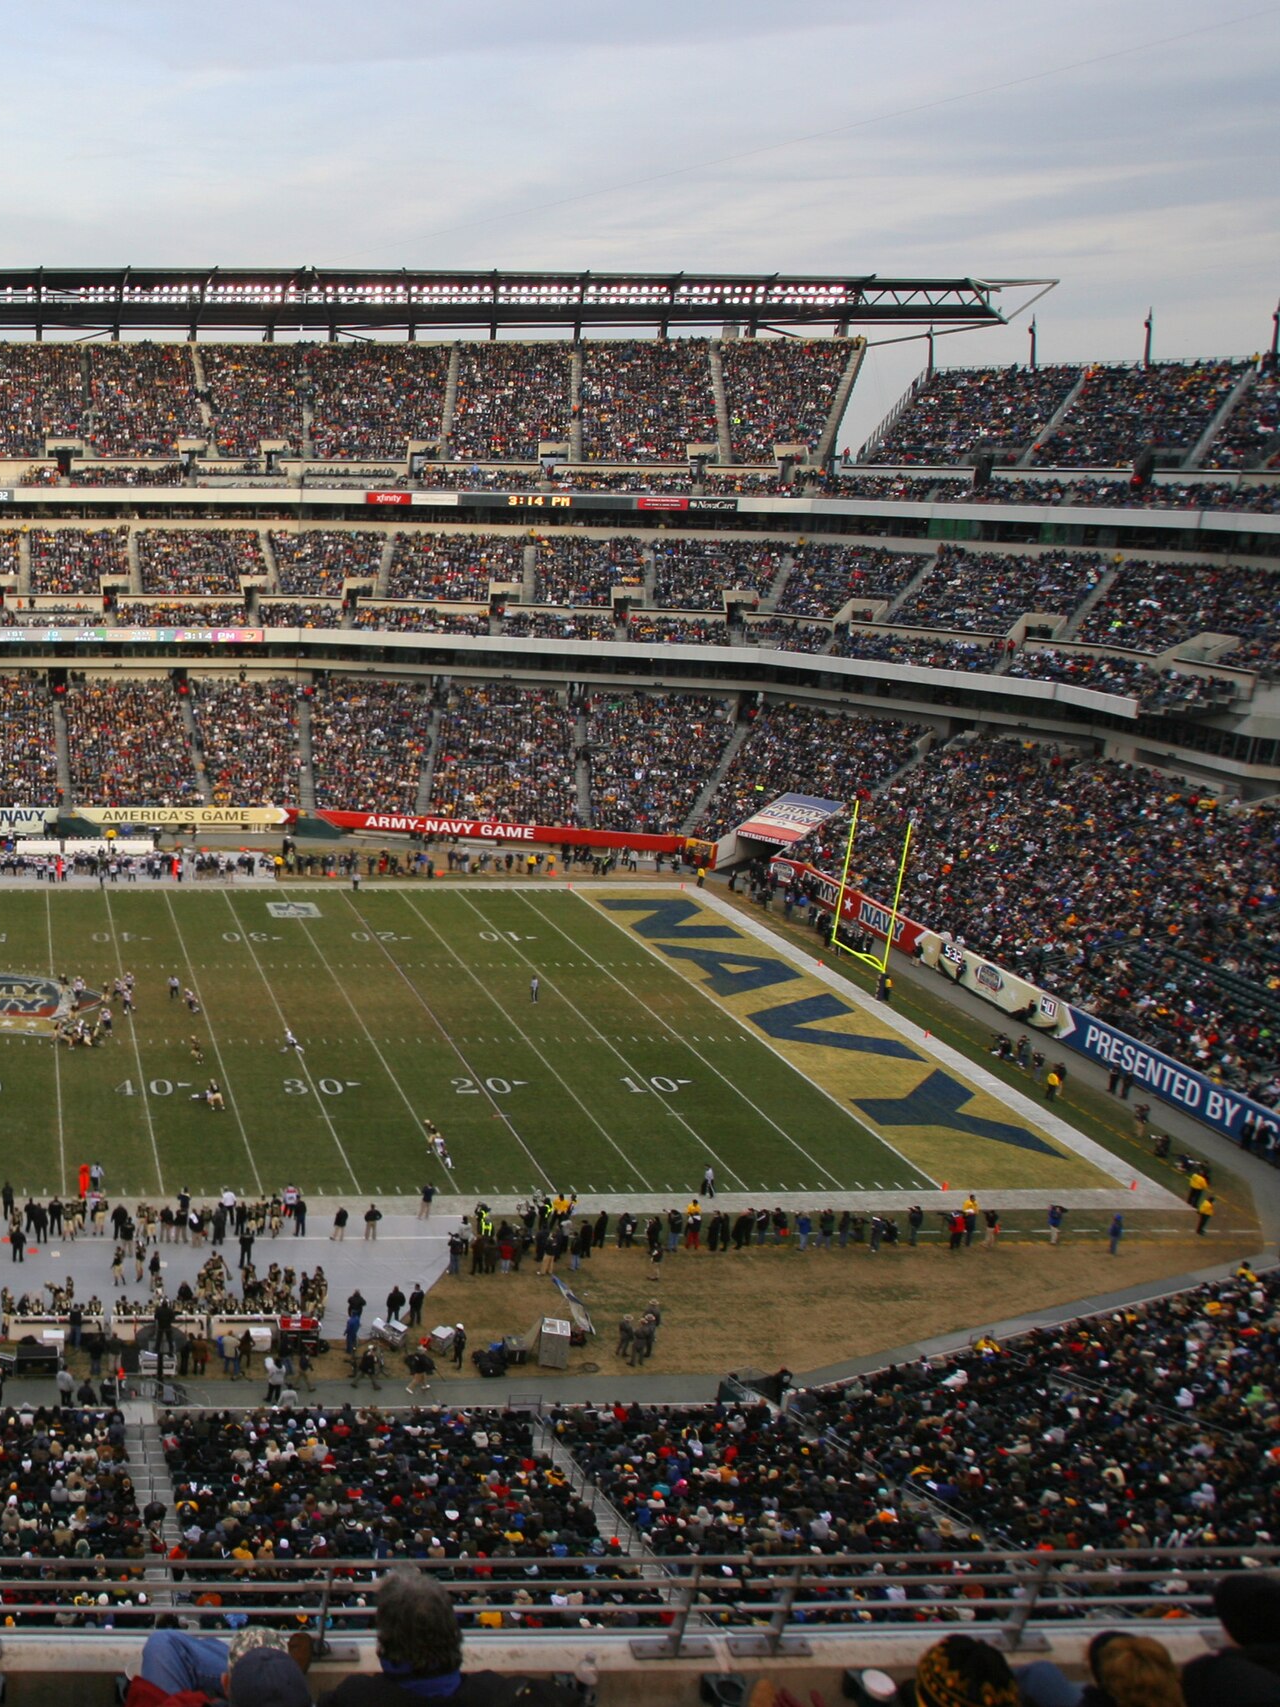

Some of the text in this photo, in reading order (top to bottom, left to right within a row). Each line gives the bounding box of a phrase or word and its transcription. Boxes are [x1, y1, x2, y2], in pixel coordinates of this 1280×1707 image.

[376, 493, 402, 504] xfinity
[508, 496, 571, 507] 3:14 PM
[697, 500, 736, 511] NovaCare
[184, 632, 235, 640] 3:14 PM
[0, 810, 46, 821] NAVY
[102, 810, 250, 821] AMERICA'S GAME
[765, 809, 821, 825] NAVY
[772, 803, 824, 818] ARMY
[365, 815, 535, 840] ARMY-NAVY GAME
[858, 898, 906, 943] NAVY
[944, 944, 963, 965] 5:32
[1041, 996, 1056, 1017] 40
[593, 899, 1070, 1161] NAVY
[1084, 1024, 1241, 1128] PRESENTED BY
[114, 1078, 174, 1096] 40
[283, 1078, 344, 1096] 30
[450, 1077, 512, 1094] 20
[620, 1076, 680, 1094] 10
